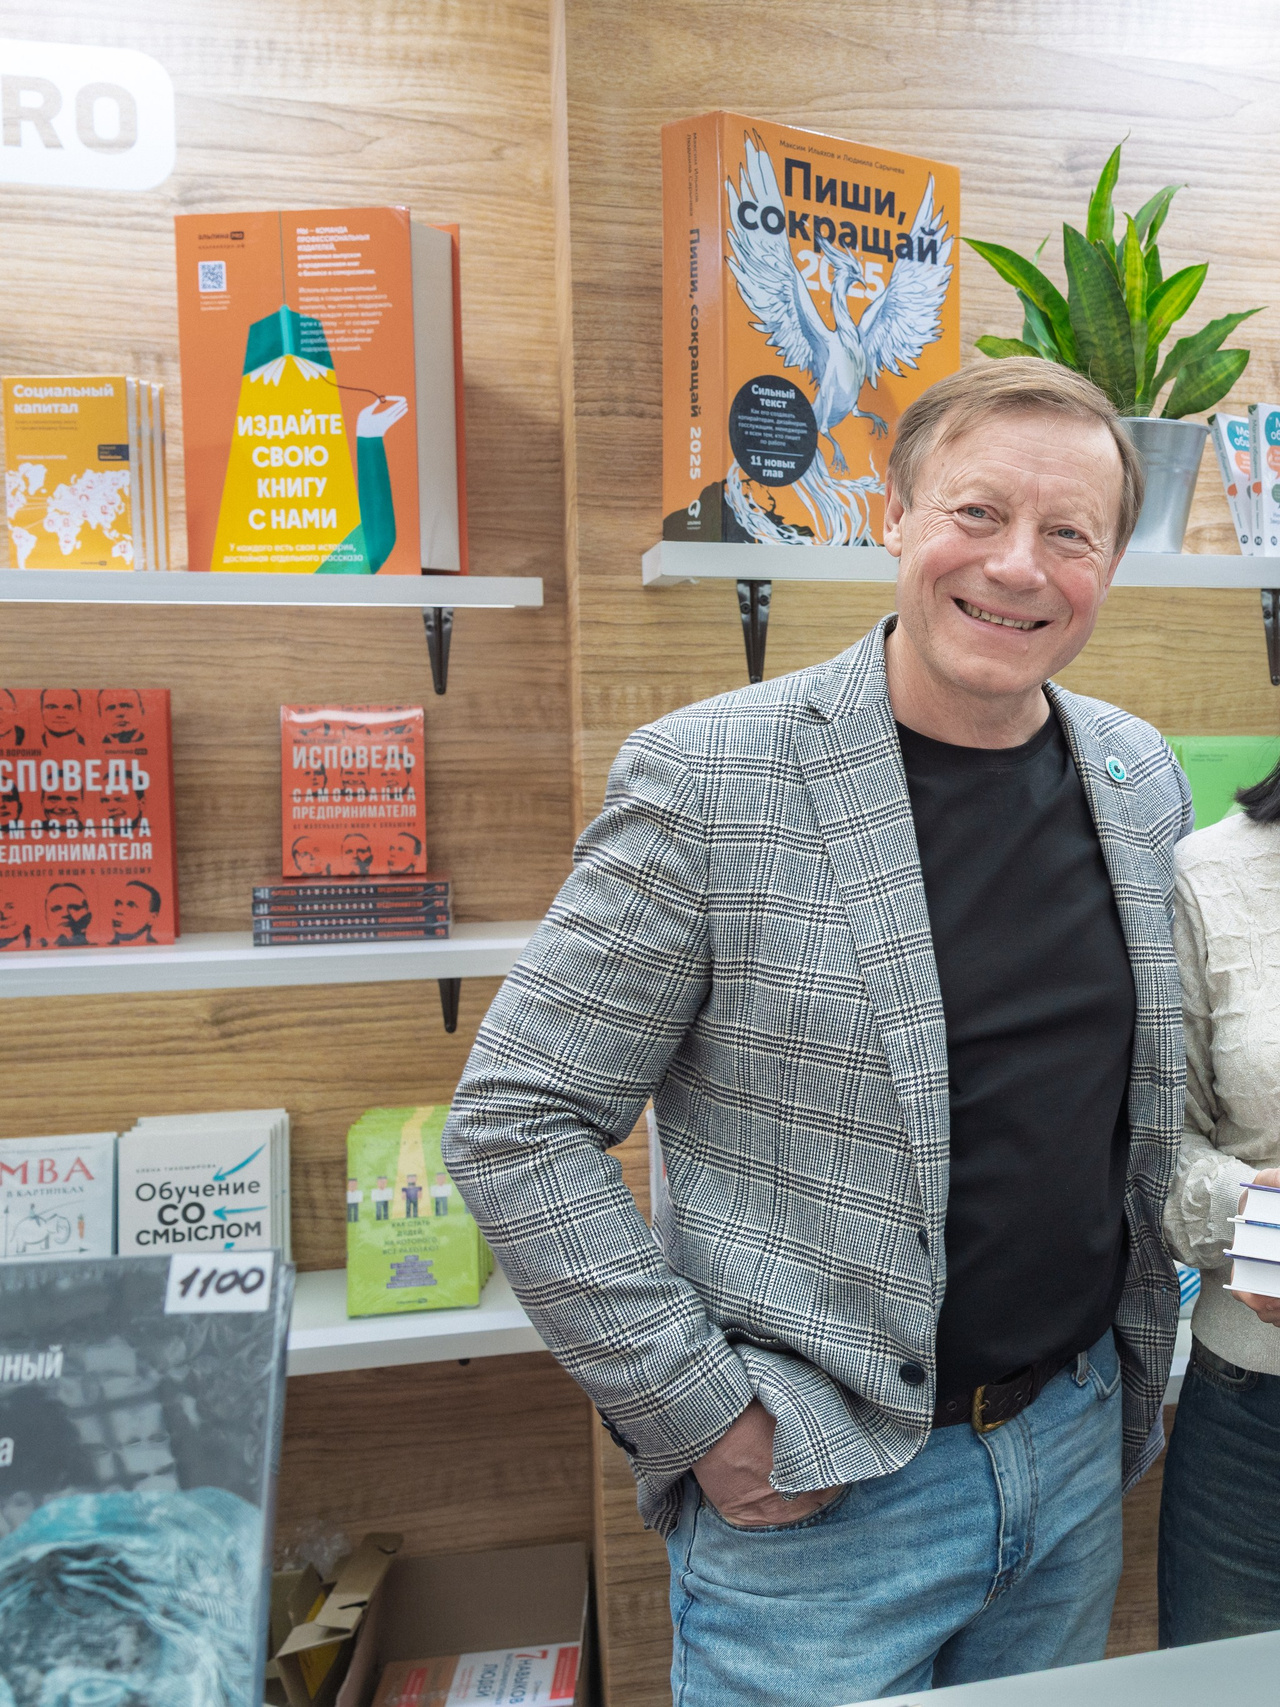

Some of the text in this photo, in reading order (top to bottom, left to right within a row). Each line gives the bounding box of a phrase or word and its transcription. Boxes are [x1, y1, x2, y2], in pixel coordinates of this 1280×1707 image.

[779, 139, 806, 152] Максим
[784, 157, 906, 226] Пиши,
[736, 200, 938, 266] сокращай
[688, 228, 702, 480] Пиши, сокращай 2025
[12, 383, 114, 399] Социальный
[751, 384, 796, 399] Сильный
[14, 402, 80, 414] капитал
[760, 398, 787, 409] текст
[237, 409, 342, 439] ИЗДАЙТЕ
[252, 445, 329, 468] СВОЮ
[751, 455, 796, 469] 11 новых
[762, 469, 784, 479] глав
[257, 477, 327, 498] КНИГУ
[248, 508, 338, 530] С НАМИ
[292, 745, 416, 770] ИСПОВЕДЬ
[292, 786, 416, 803] САМОЗВАНЦА
[292, 804, 417, 820] ПРЕДПРИНИМАТЕЛЯ
[0, 1156, 95, 1187] MBA
[135, 1179, 261, 1204] Обучение
[179, 1267, 265, 1298] 1100
